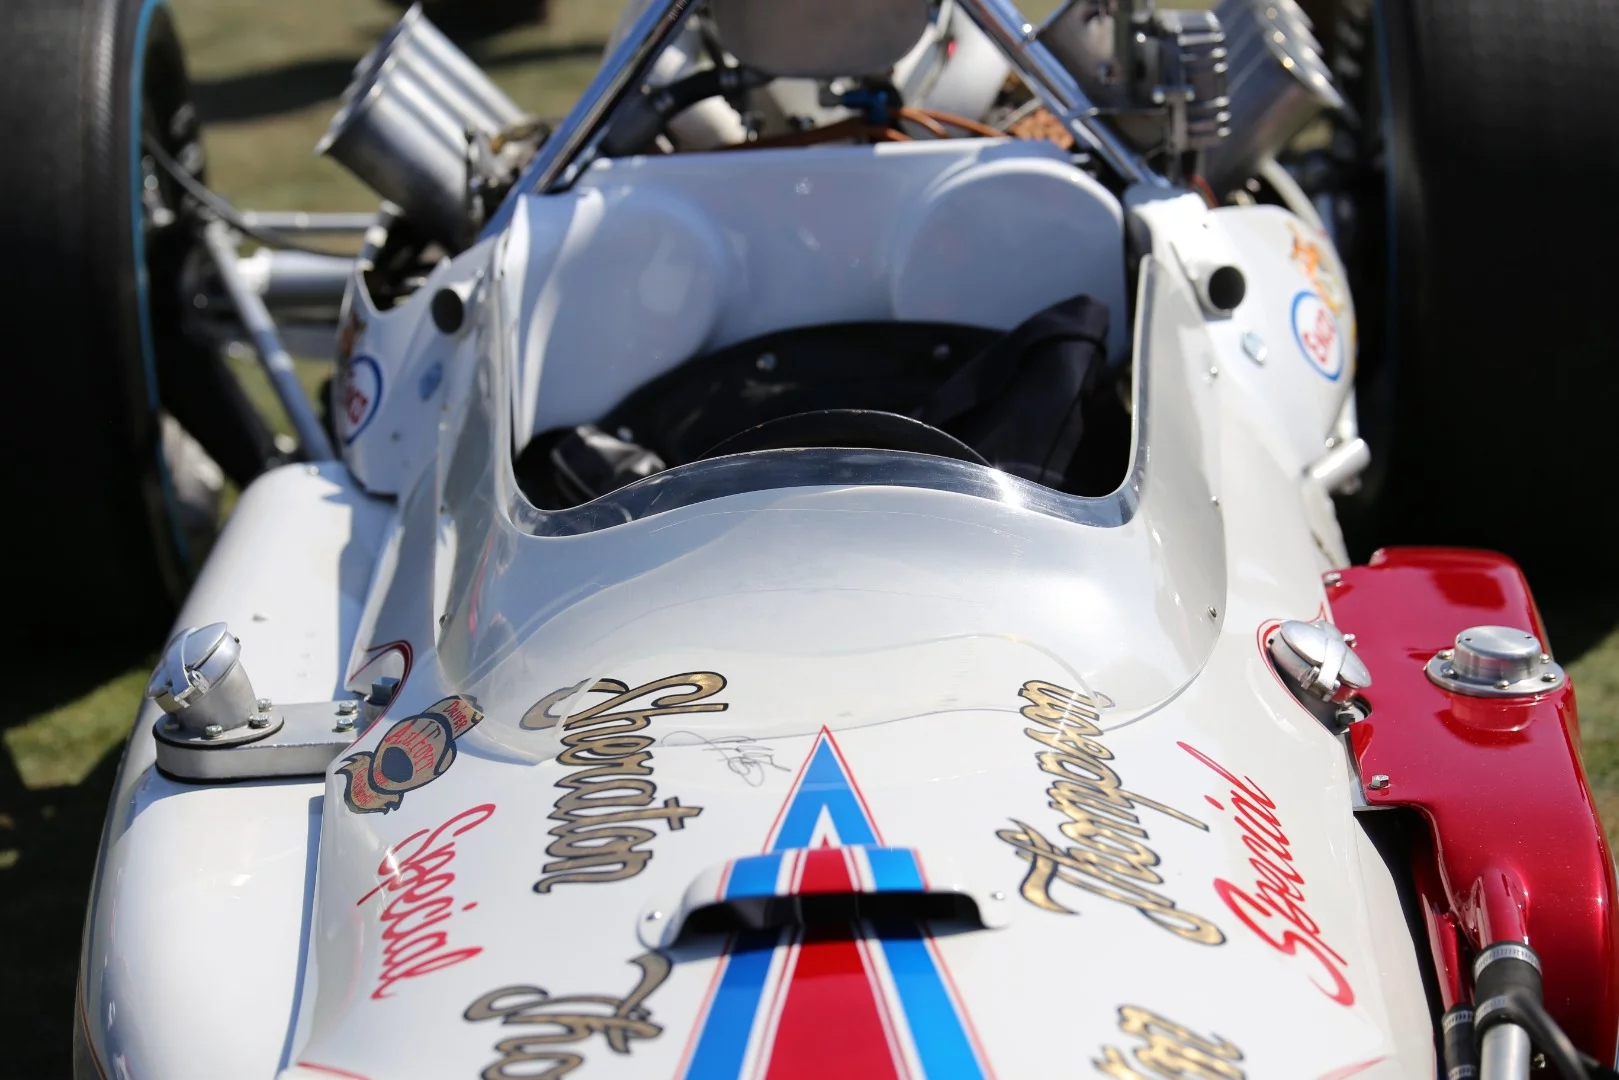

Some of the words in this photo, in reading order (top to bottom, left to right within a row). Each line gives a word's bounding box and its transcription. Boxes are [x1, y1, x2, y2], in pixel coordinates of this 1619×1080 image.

[443, 700, 469, 733] DRIVER
[518, 671, 729, 894] Sheraton
[995, 680, 1227, 945] Thompson
[357, 803, 496, 999] Special
[1176, 740, 1355, 1006] Special
